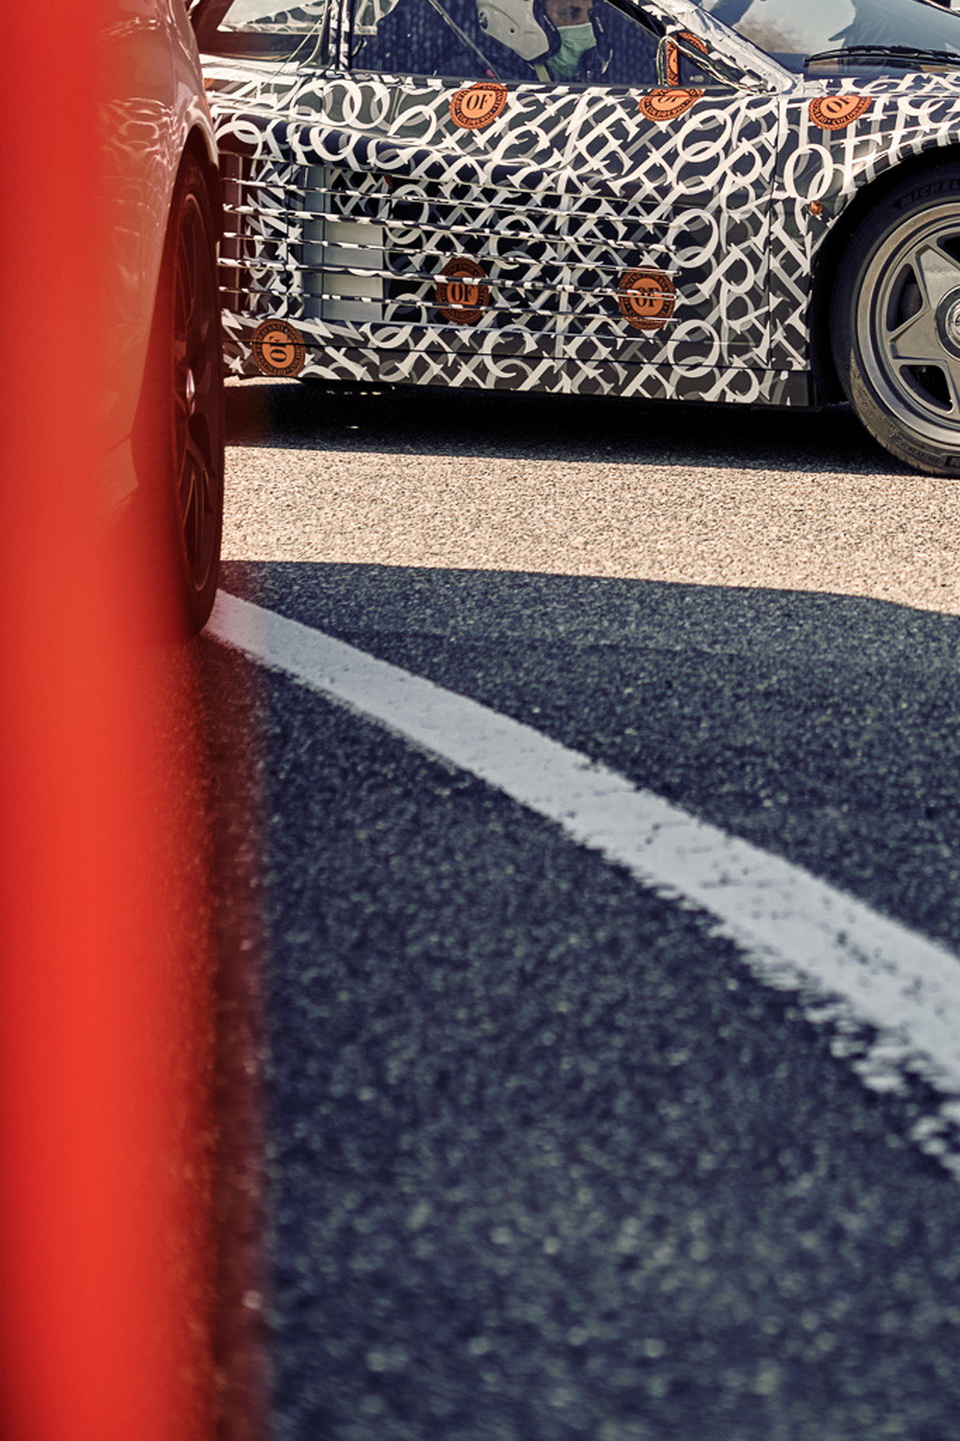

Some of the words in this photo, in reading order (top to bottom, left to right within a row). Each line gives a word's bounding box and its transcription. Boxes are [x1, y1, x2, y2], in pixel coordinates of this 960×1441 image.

[466, 94, 493, 110] OF
[451, 281, 473, 303] OF
[268, 336, 288, 363] OF
